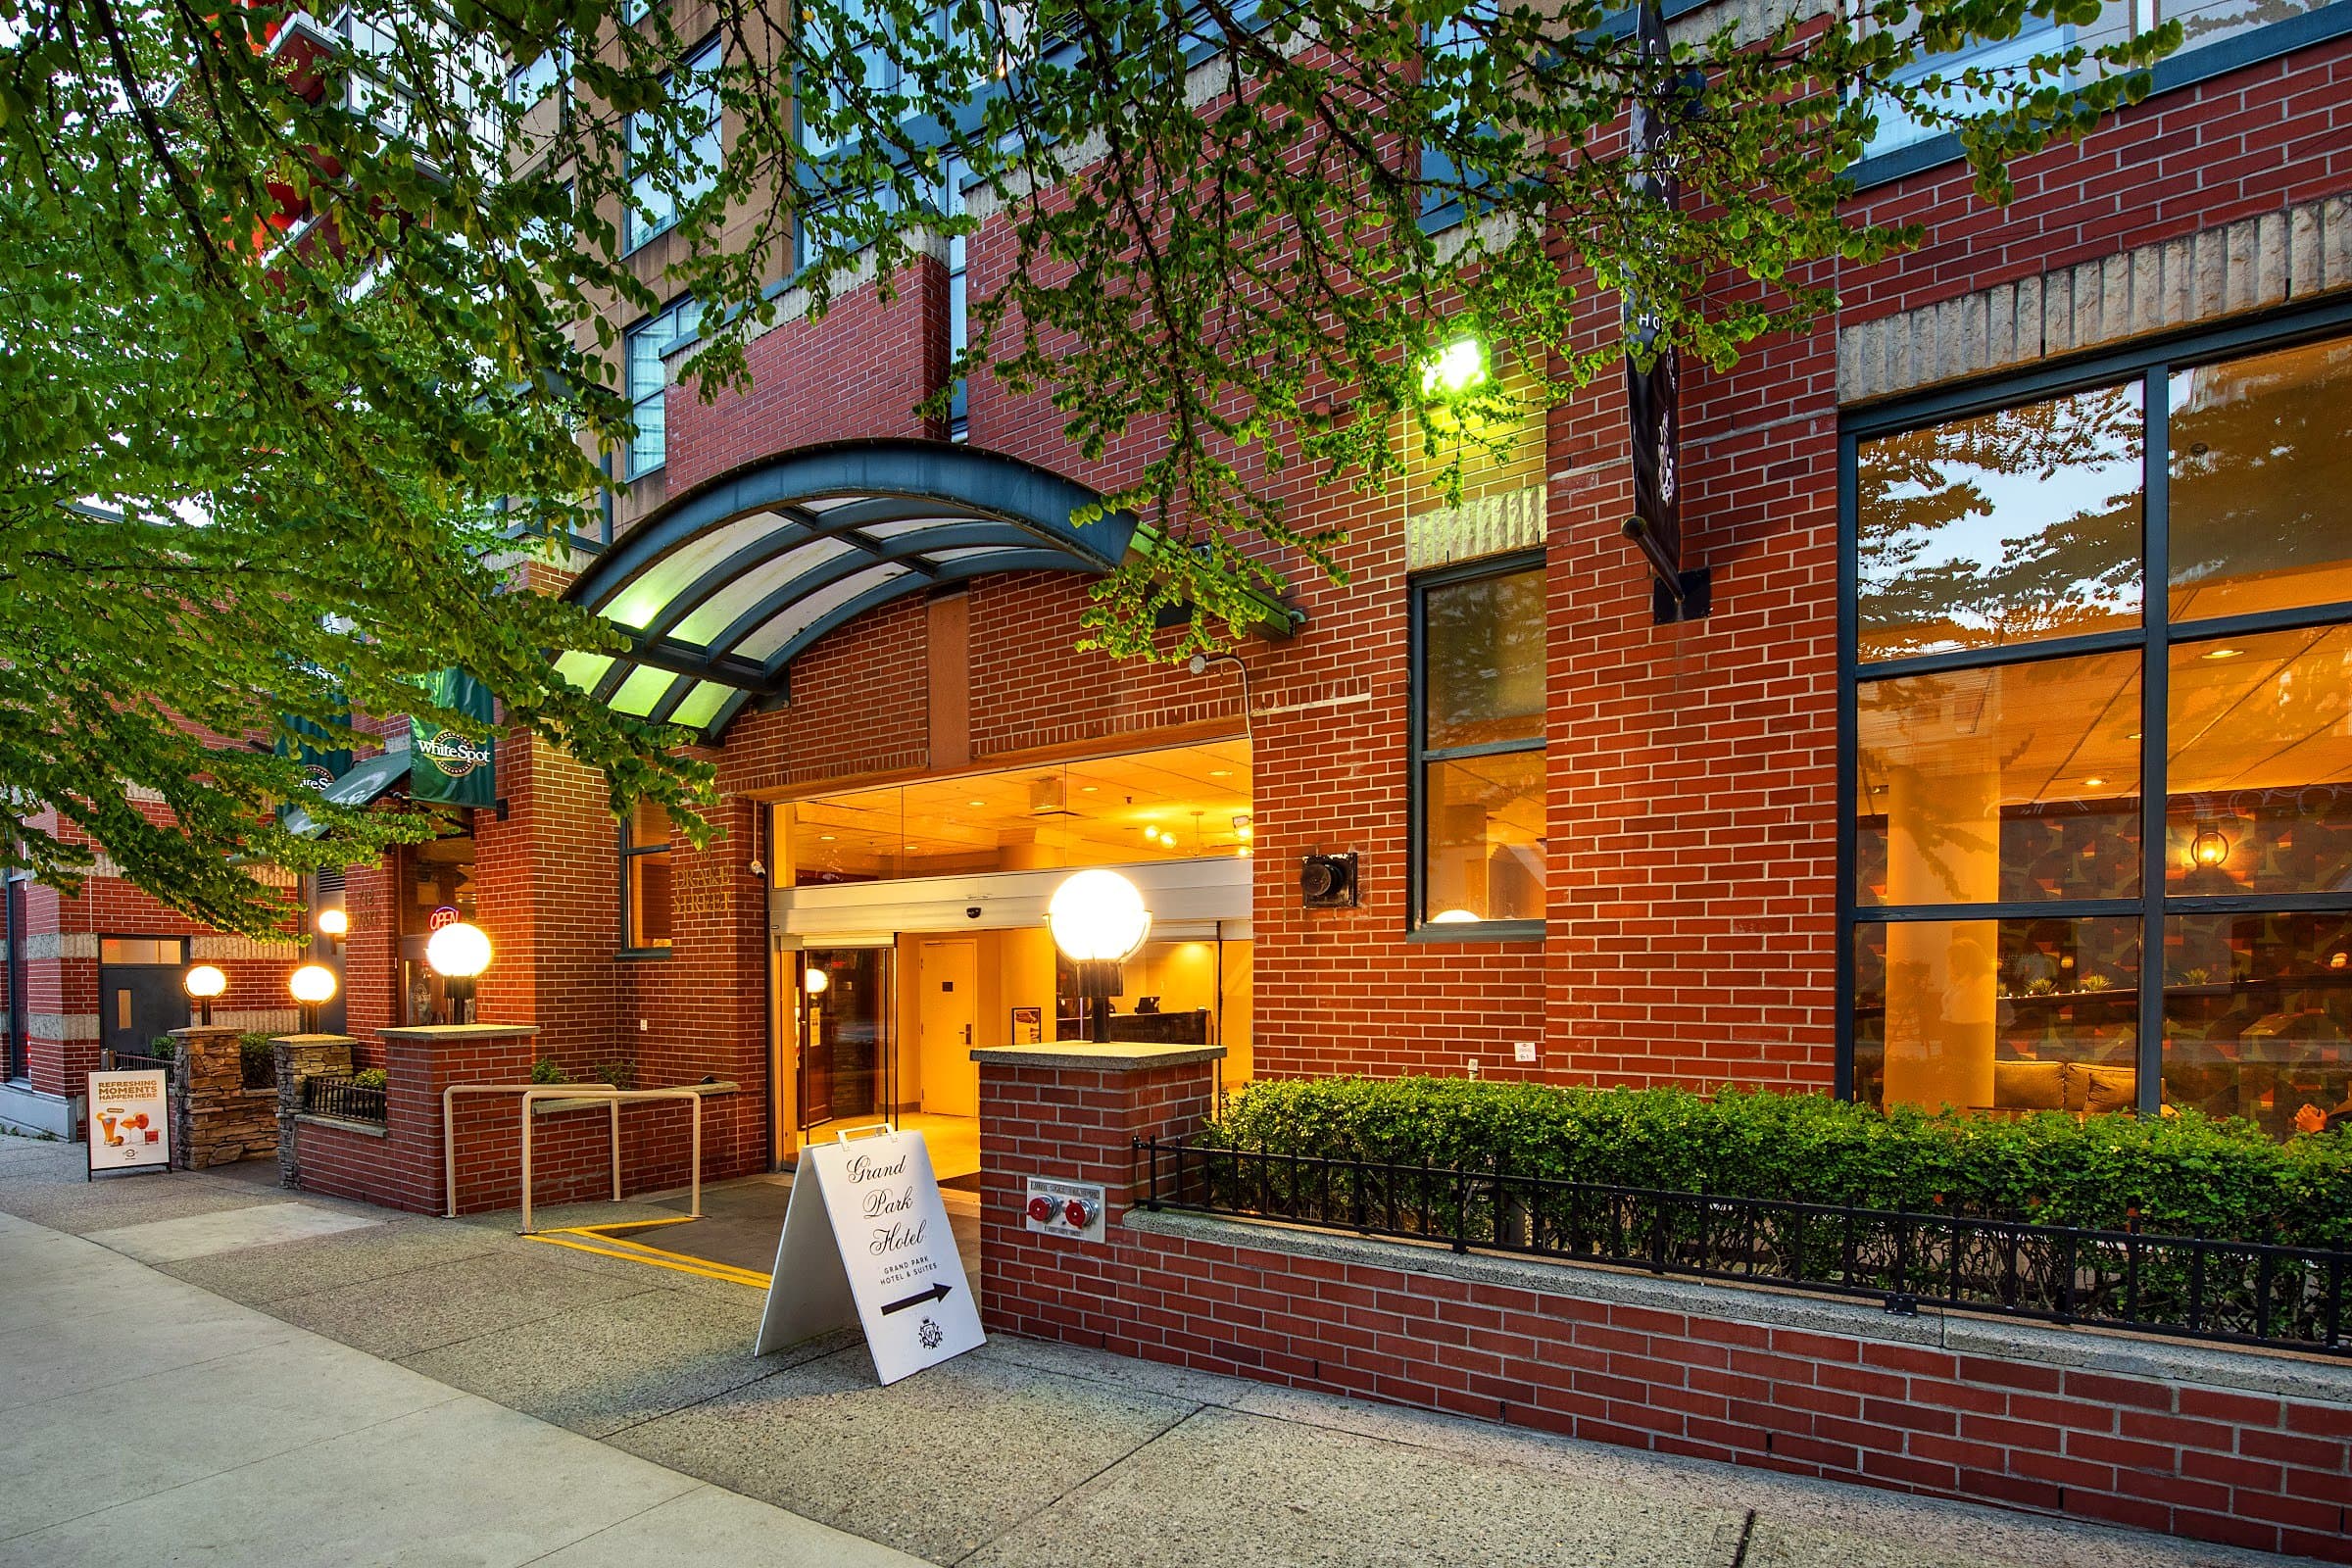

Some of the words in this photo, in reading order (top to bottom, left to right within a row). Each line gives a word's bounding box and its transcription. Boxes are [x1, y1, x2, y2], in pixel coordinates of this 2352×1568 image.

[675, 866, 731, 888] DRAKE
[673, 891, 731, 912] STREET
[429, 910, 459, 930] OPEN
[847, 1154, 906, 1184] Grand
[862, 1186, 912, 1219] Park
[869, 1220, 926, 1256] Hotel
[880, 1274, 905, 1286] HOTEL
[913, 1262, 937, 1276] SUITES
[884, 1263, 908, 1275] GRAND
[911, 1255, 929, 1267] PARK
